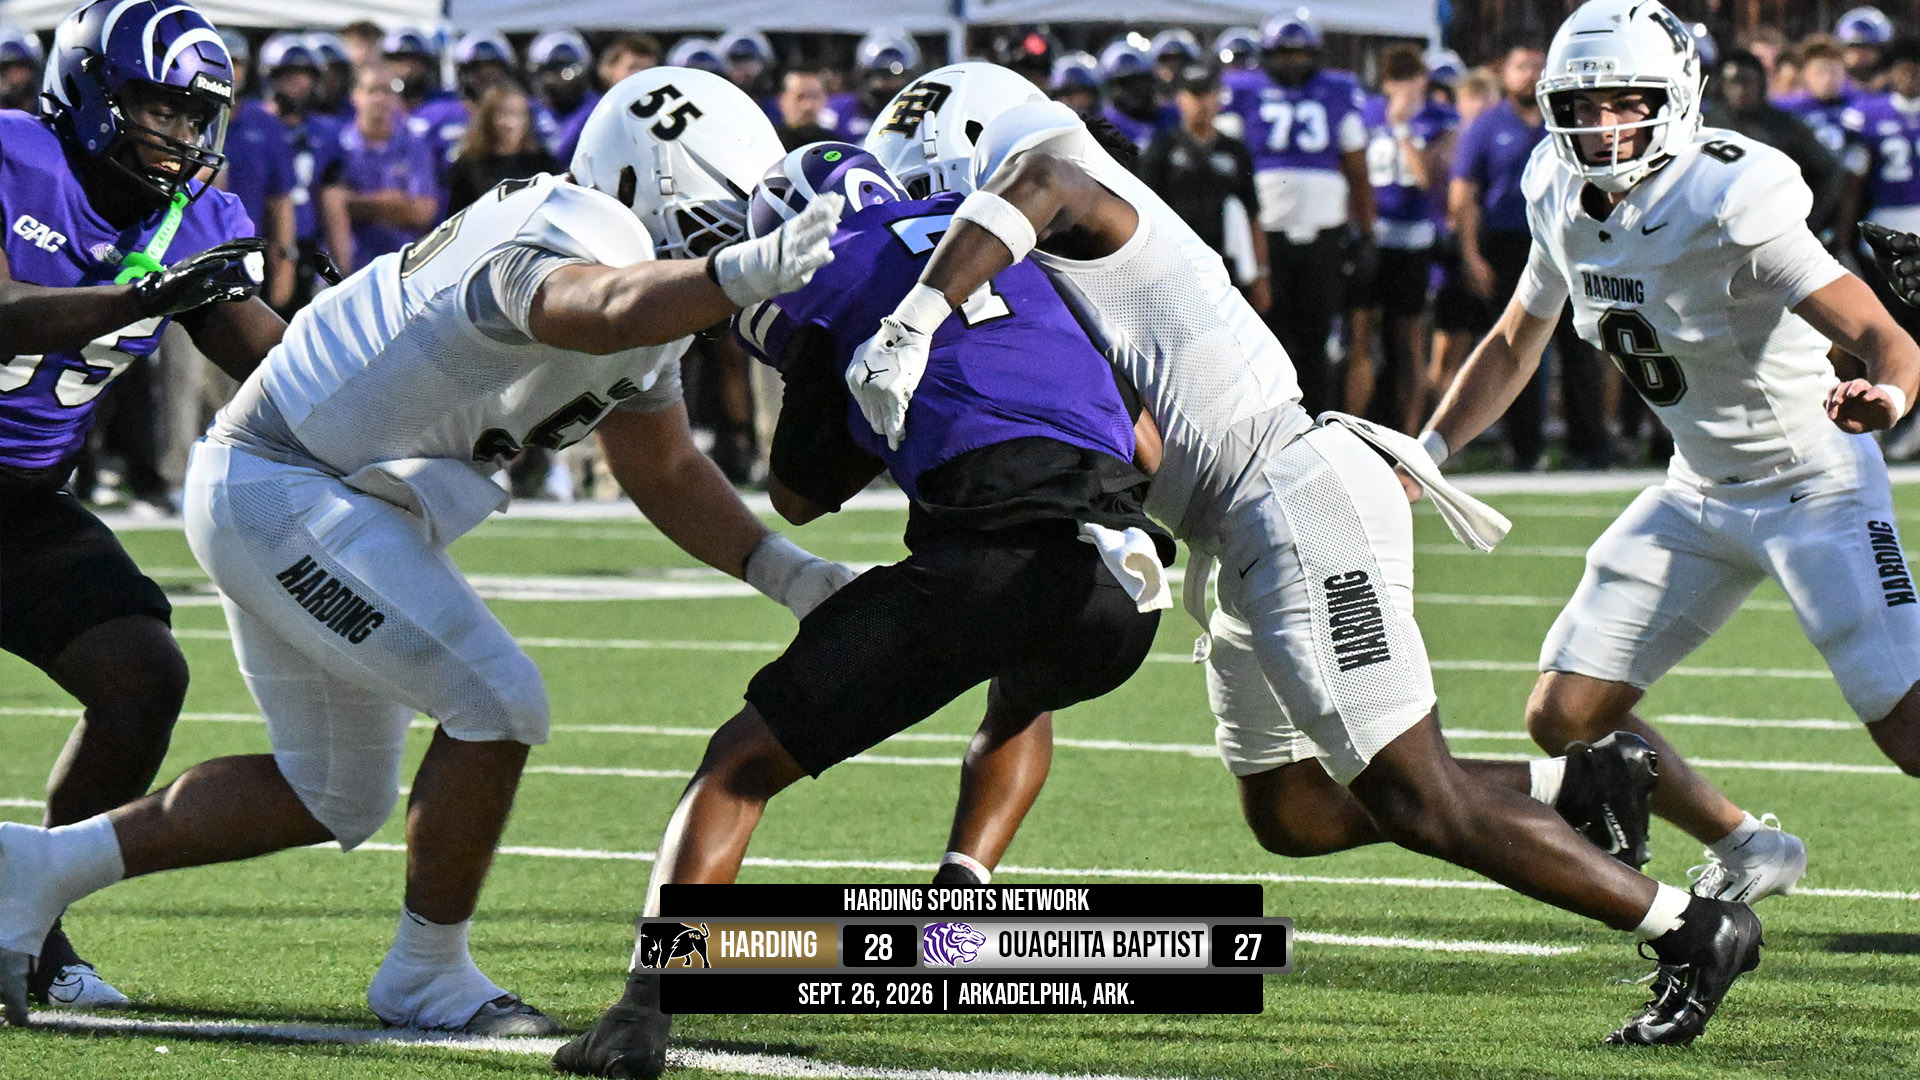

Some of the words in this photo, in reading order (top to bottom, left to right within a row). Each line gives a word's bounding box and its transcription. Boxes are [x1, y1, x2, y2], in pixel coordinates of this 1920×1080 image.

[195, 74, 232, 98] Riddell
[628, 83, 704, 142] 55
[1258, 100, 1331, 153] 73
[1700, 139, 1747, 165] 6
[13, 215, 67, 254] GAC
[1581, 271, 1646, 305] HARDING
[1597, 307, 1689, 408] 6
[1867, 520, 1917, 608] HARDING
[275, 554, 386, 645] HARDING
[1323, 569, 1392, 673] HARDING
